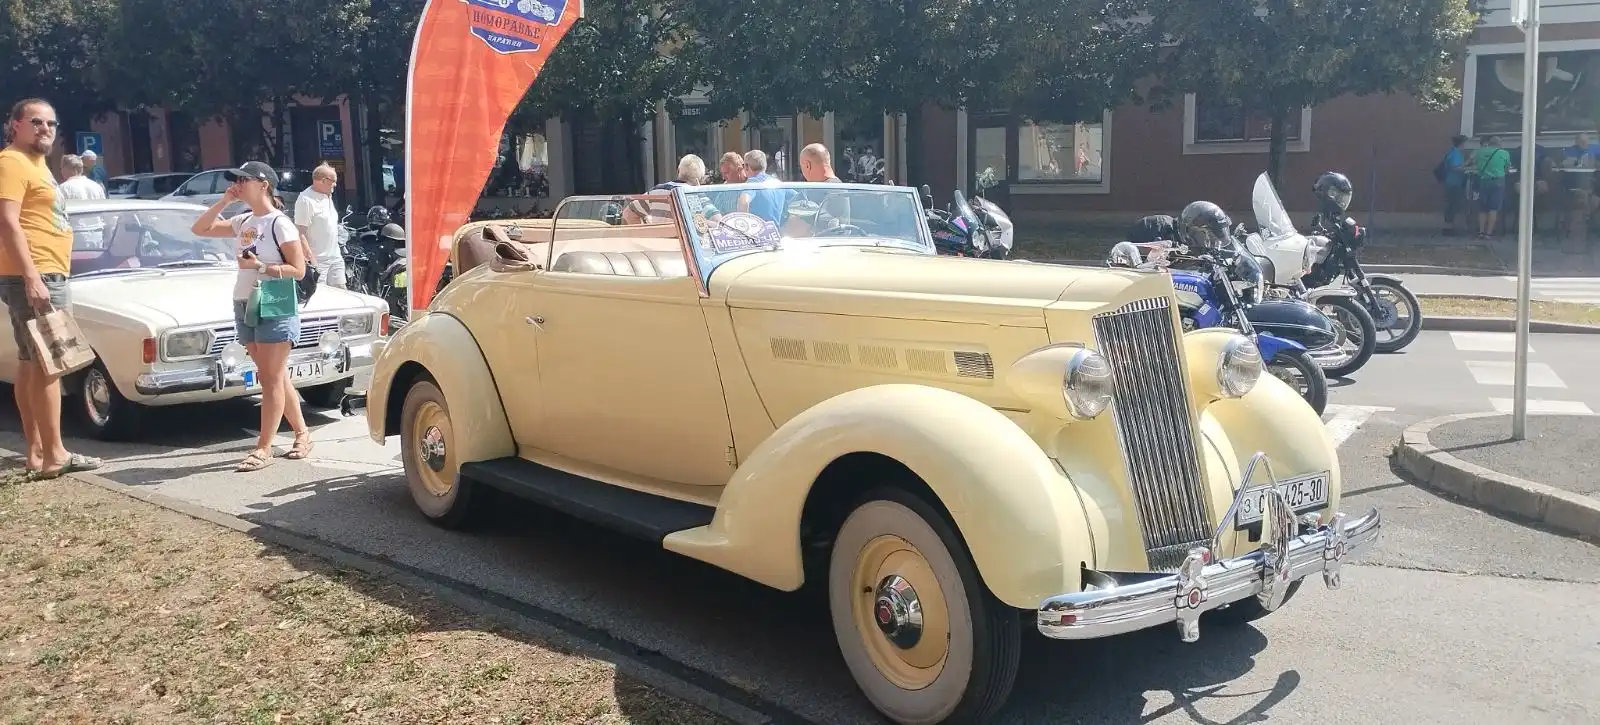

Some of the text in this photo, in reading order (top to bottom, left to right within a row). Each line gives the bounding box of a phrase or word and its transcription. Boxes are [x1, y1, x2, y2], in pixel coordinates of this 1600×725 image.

[323, 123, 335, 141] P
[83, 136, 96, 151] P
[1284, 478, 1323, 507] 425-30
